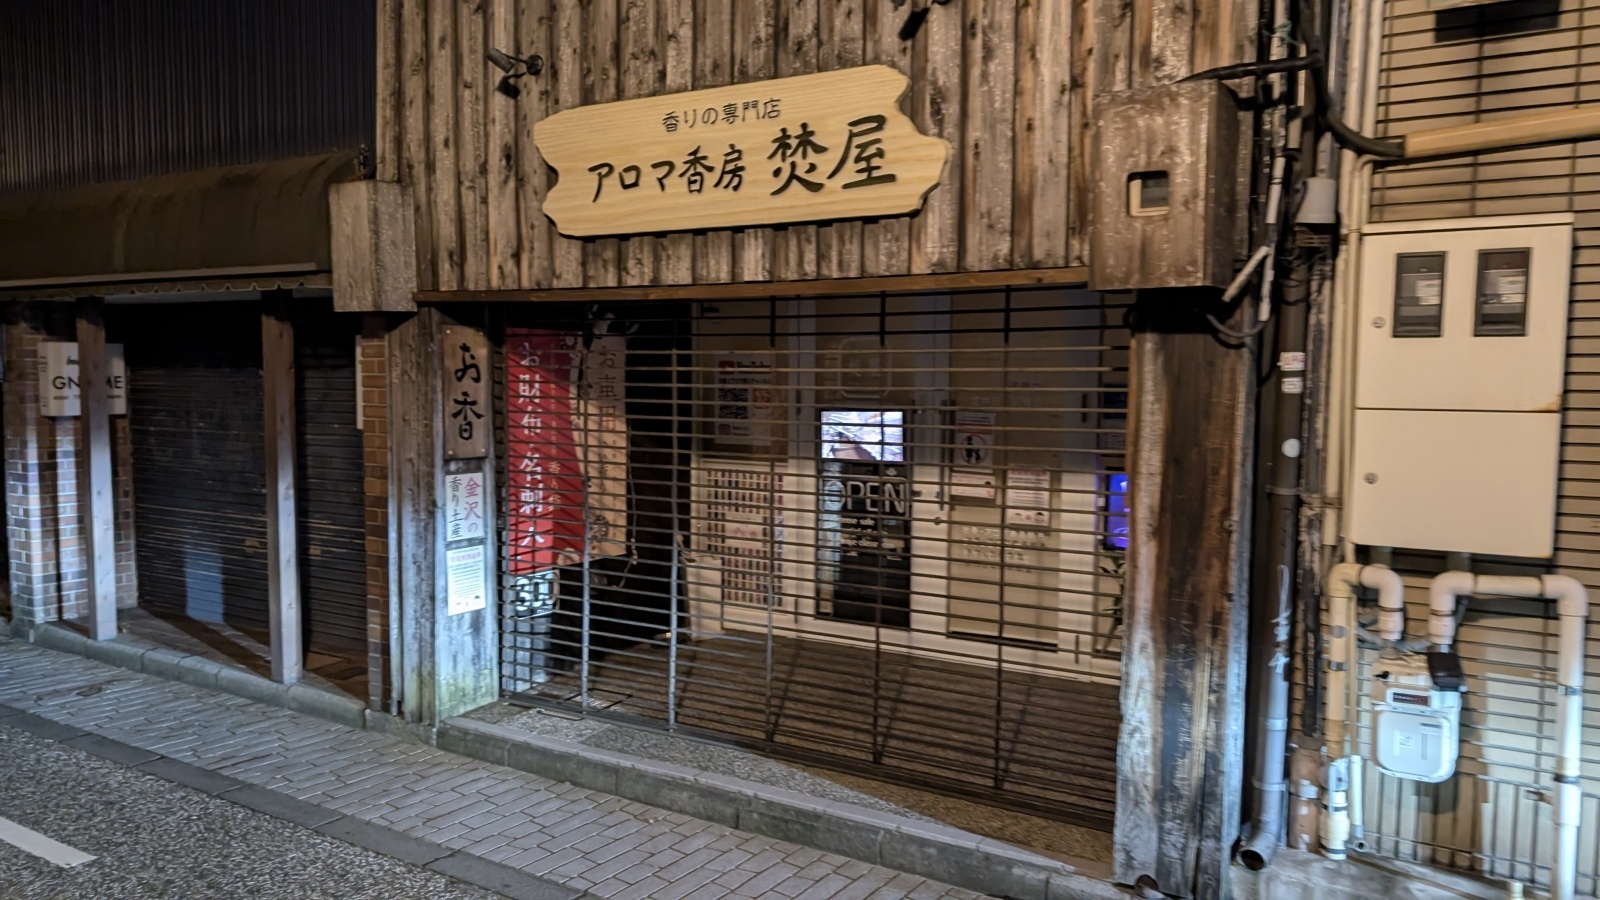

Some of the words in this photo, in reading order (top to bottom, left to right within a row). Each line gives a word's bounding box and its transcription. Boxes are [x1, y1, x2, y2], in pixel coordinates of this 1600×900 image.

[661, 97, 782, 133] 香りの専門店
[587, 143, 746, 203] アロマ香房
[767, 114, 897, 196] 焚屋
[451, 342, 485, 441] お香
[448, 475, 463, 539] 香り土産
[464, 476, 482, 534] 金沢の
